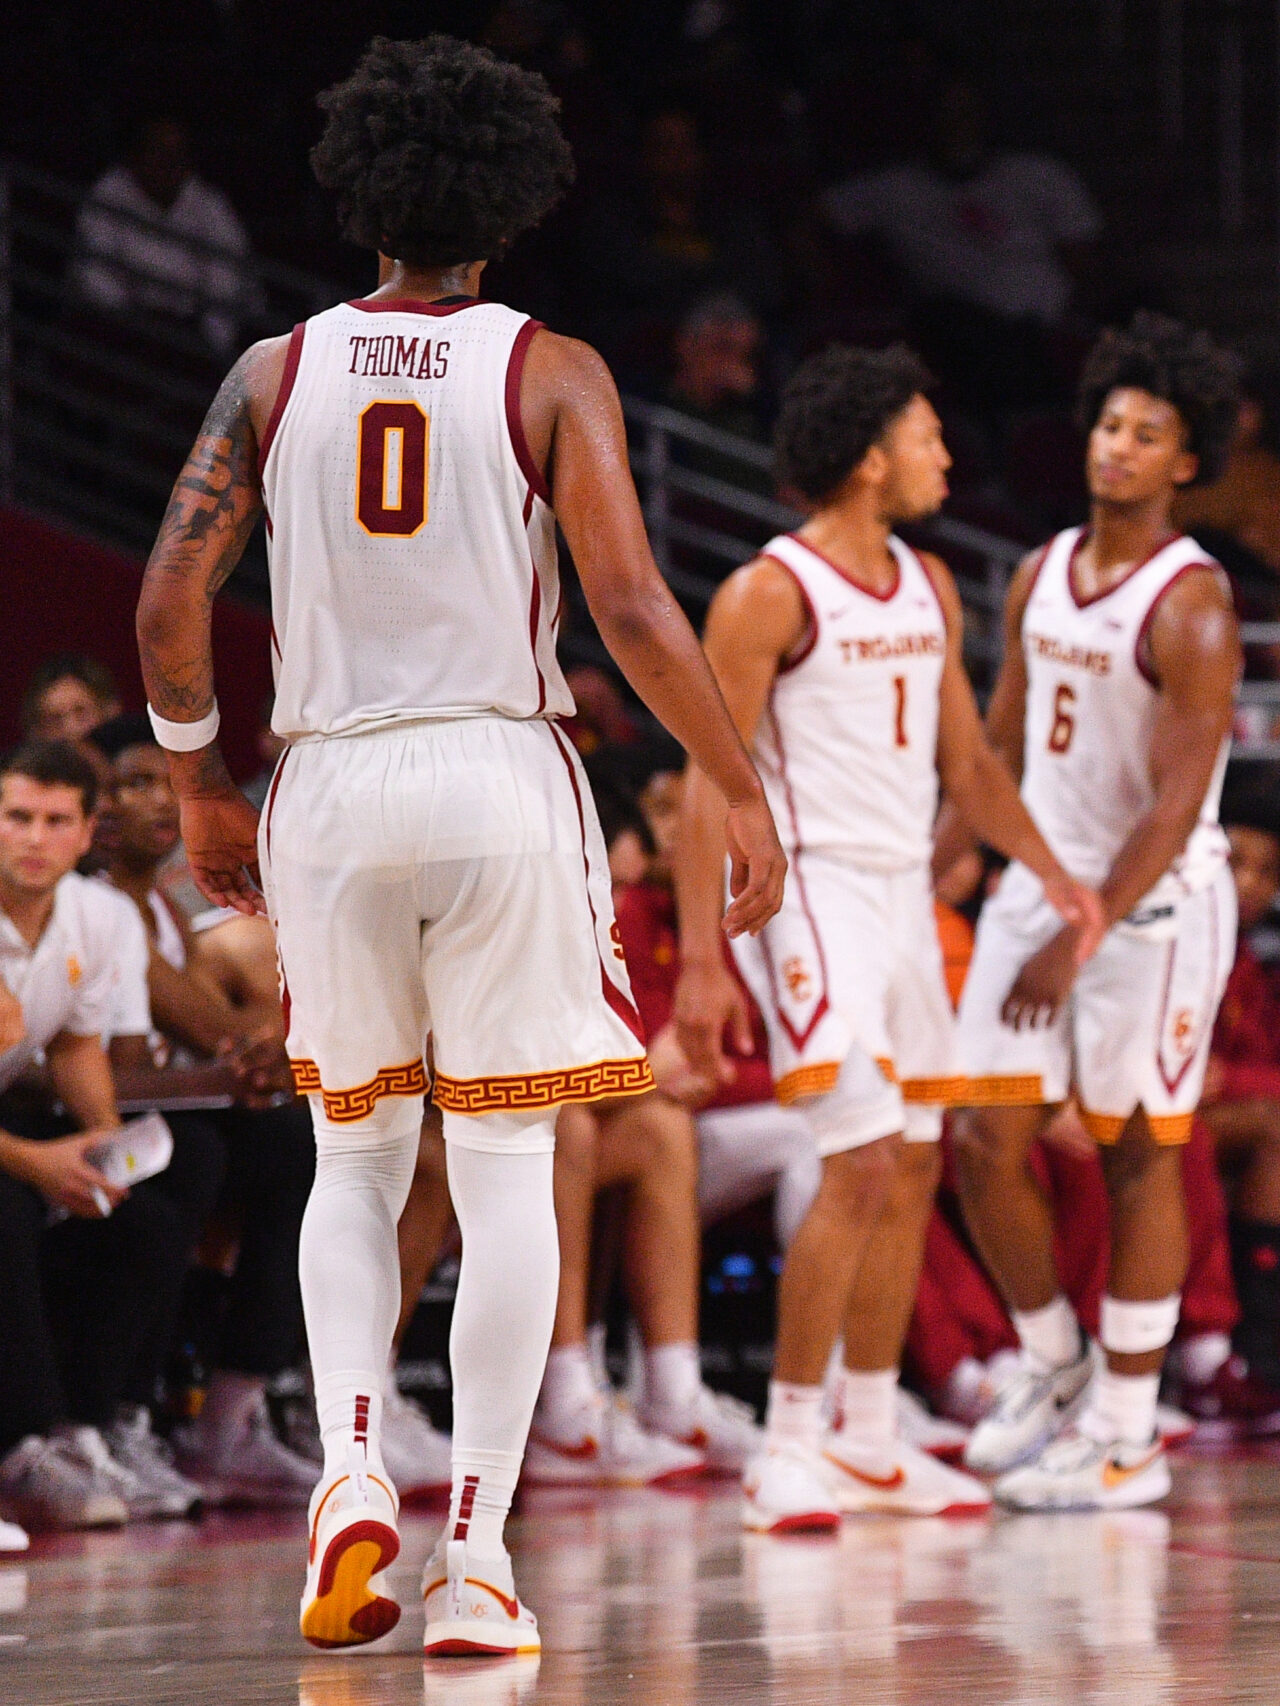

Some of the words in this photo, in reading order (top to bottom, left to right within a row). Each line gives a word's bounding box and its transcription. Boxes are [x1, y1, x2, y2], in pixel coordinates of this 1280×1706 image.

[349, 335, 450, 380] THOMAS
[355, 399, 430, 538] 0
[892, 675, 908, 748] 1
[1047, 683, 1077, 755] 6
